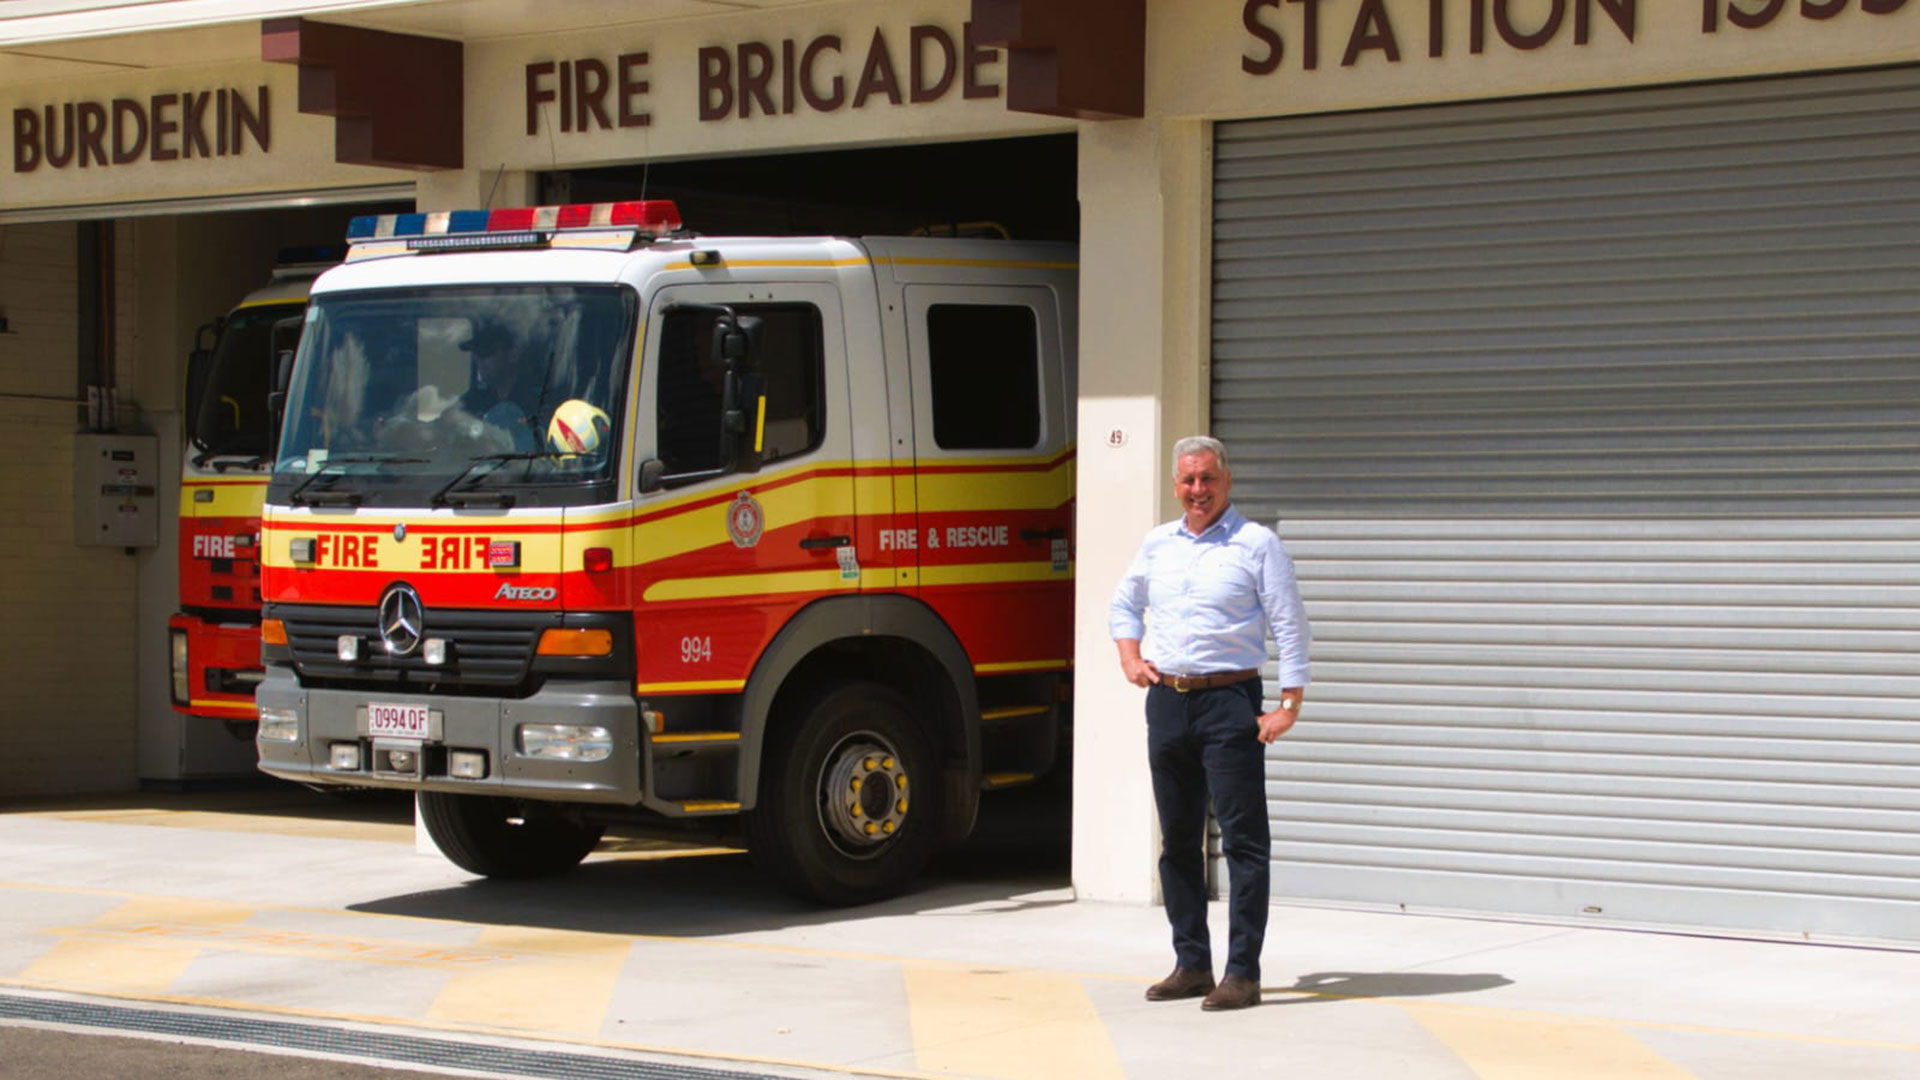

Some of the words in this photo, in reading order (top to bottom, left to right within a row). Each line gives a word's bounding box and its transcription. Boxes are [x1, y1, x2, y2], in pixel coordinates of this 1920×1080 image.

[13, 85, 271, 173] BURDEKIN
[525, 52, 652, 136] FIRE
[699, 22, 1001, 122] BRIGADE
[1241, 0, 1634, 76] STATION
[193, 535, 236, 558] FIRE
[316, 534, 378, 568] FIRE
[879, 529, 918, 551] FIRE
[928, 528, 940, 549] &
[946, 526, 1009, 549] RESCUE
[681, 636, 712, 663] 994
